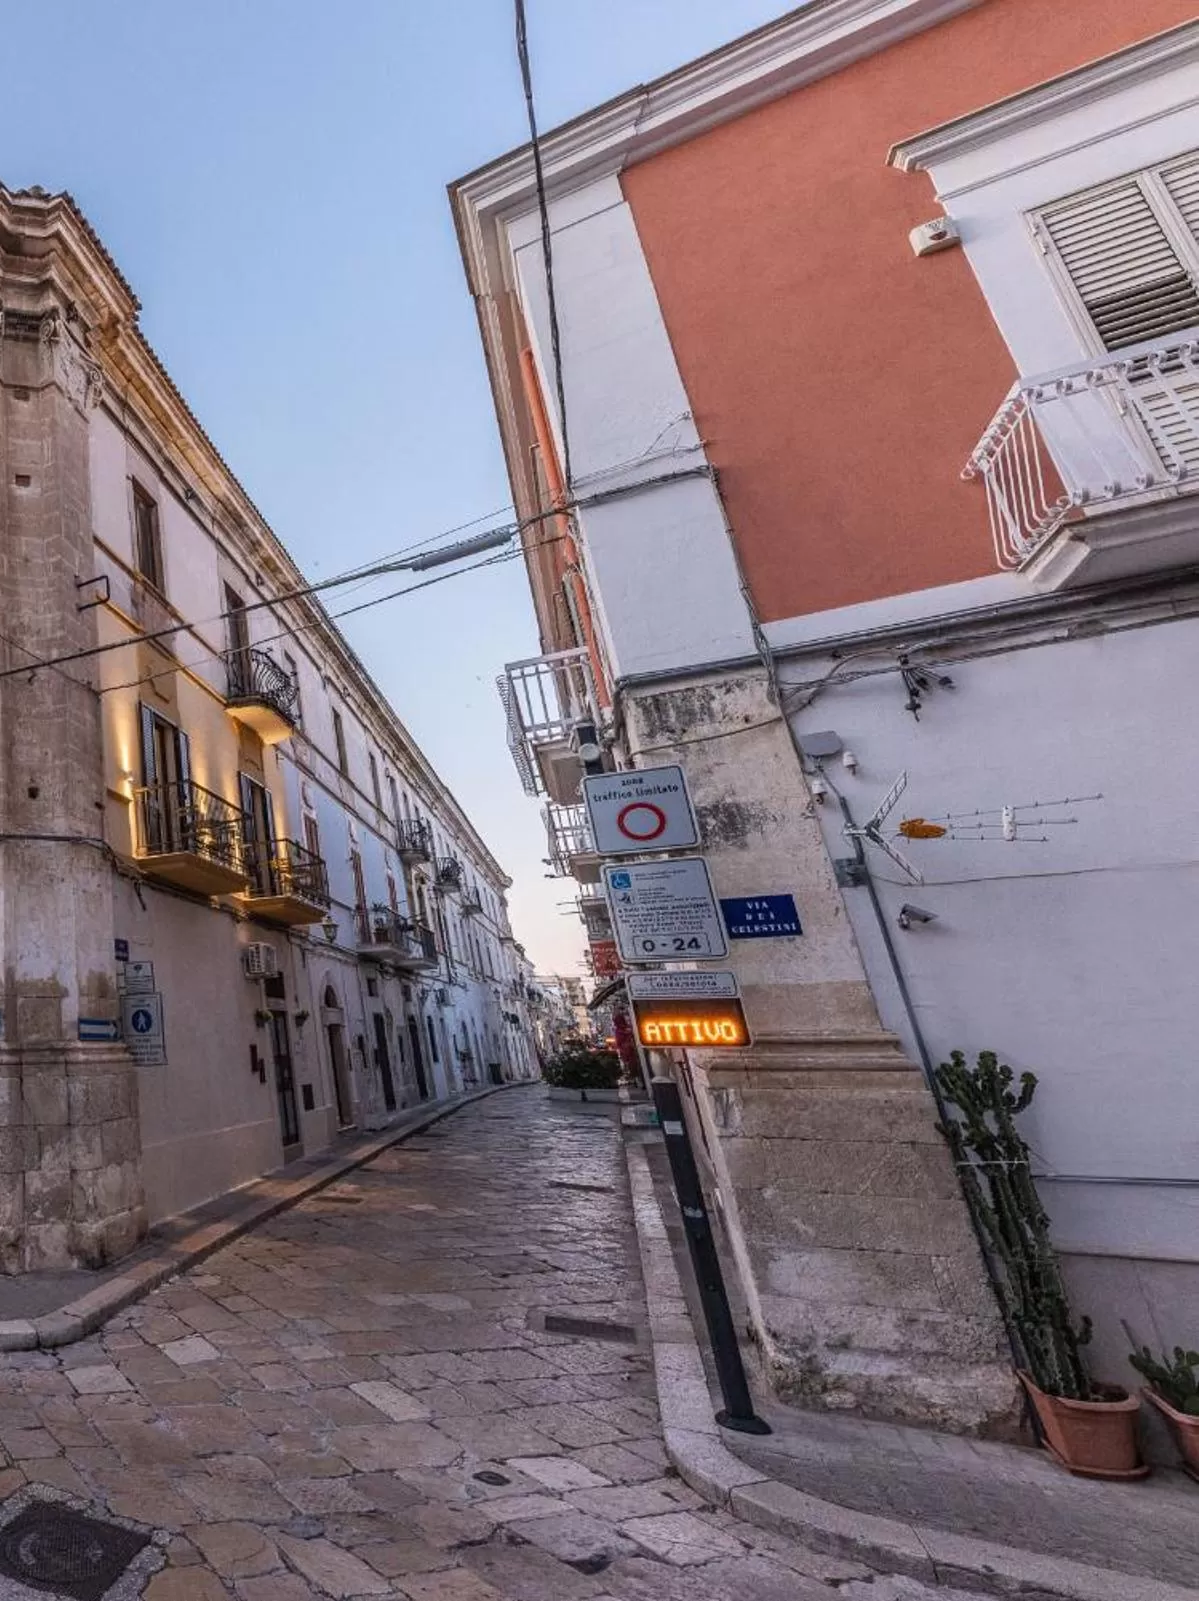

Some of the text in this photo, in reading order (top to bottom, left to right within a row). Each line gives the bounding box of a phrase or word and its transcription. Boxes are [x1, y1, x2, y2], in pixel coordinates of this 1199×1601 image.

[746, 901, 769, 910] VIA
[745, 911, 775, 921] DEI
[731, 922, 797, 933] CELESTINI
[672, 937, 702, 951] 24
[644, 1019, 738, 1042] ATTIVO
